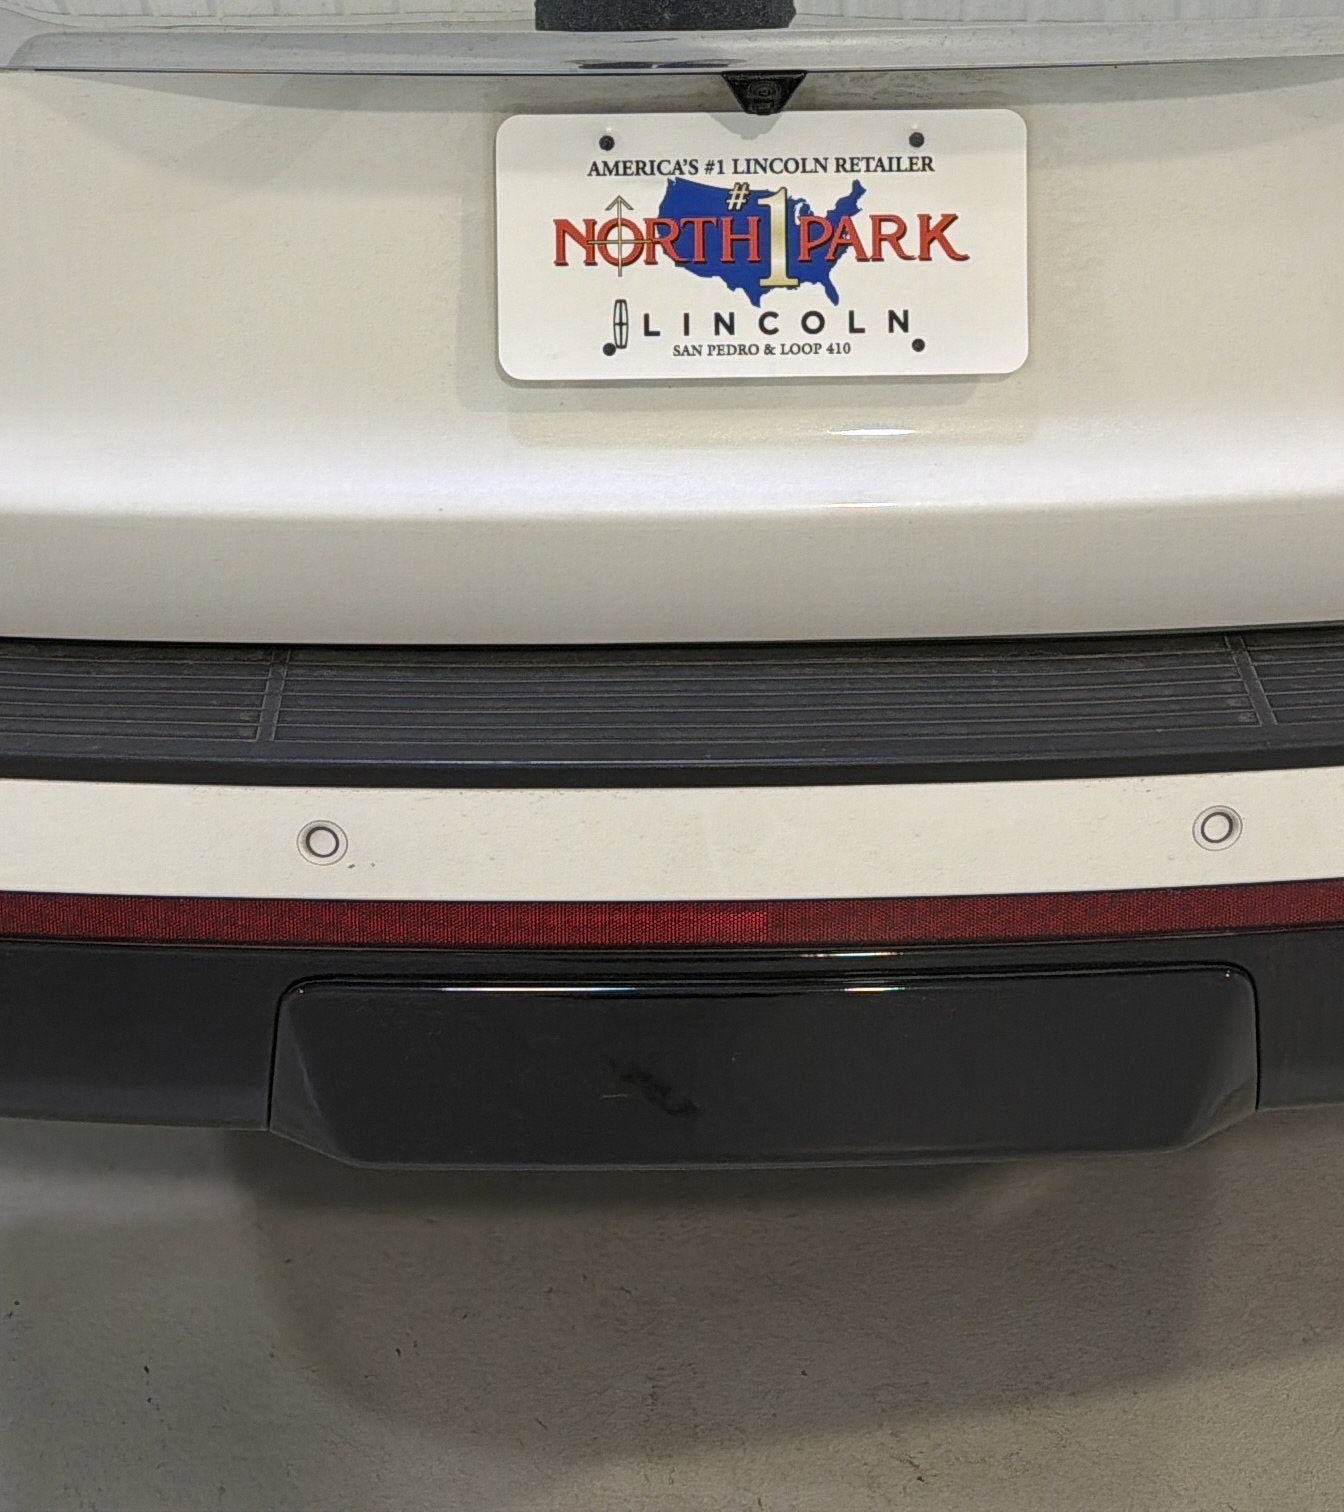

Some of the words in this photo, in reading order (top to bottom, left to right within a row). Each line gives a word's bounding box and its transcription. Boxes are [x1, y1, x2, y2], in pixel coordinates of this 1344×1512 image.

[587, 158, 699, 177] AMERICA'S
[704, 159, 726, 175] #1
[731, 157, 830, 175] LINCOLN
[834, 155, 936, 174] RETAILER
[553, 216, 762, 266] NORTH
[798, 213, 970, 262] PARK
[643, 309, 910, 337] LINCOLN
[672, 344, 703, 357] SAN
[706, 343, 760, 356] PEDRO
[763, 344, 776, 356] &
[779, 343, 823, 355] LOOP
[825, 341, 851, 355] 410
